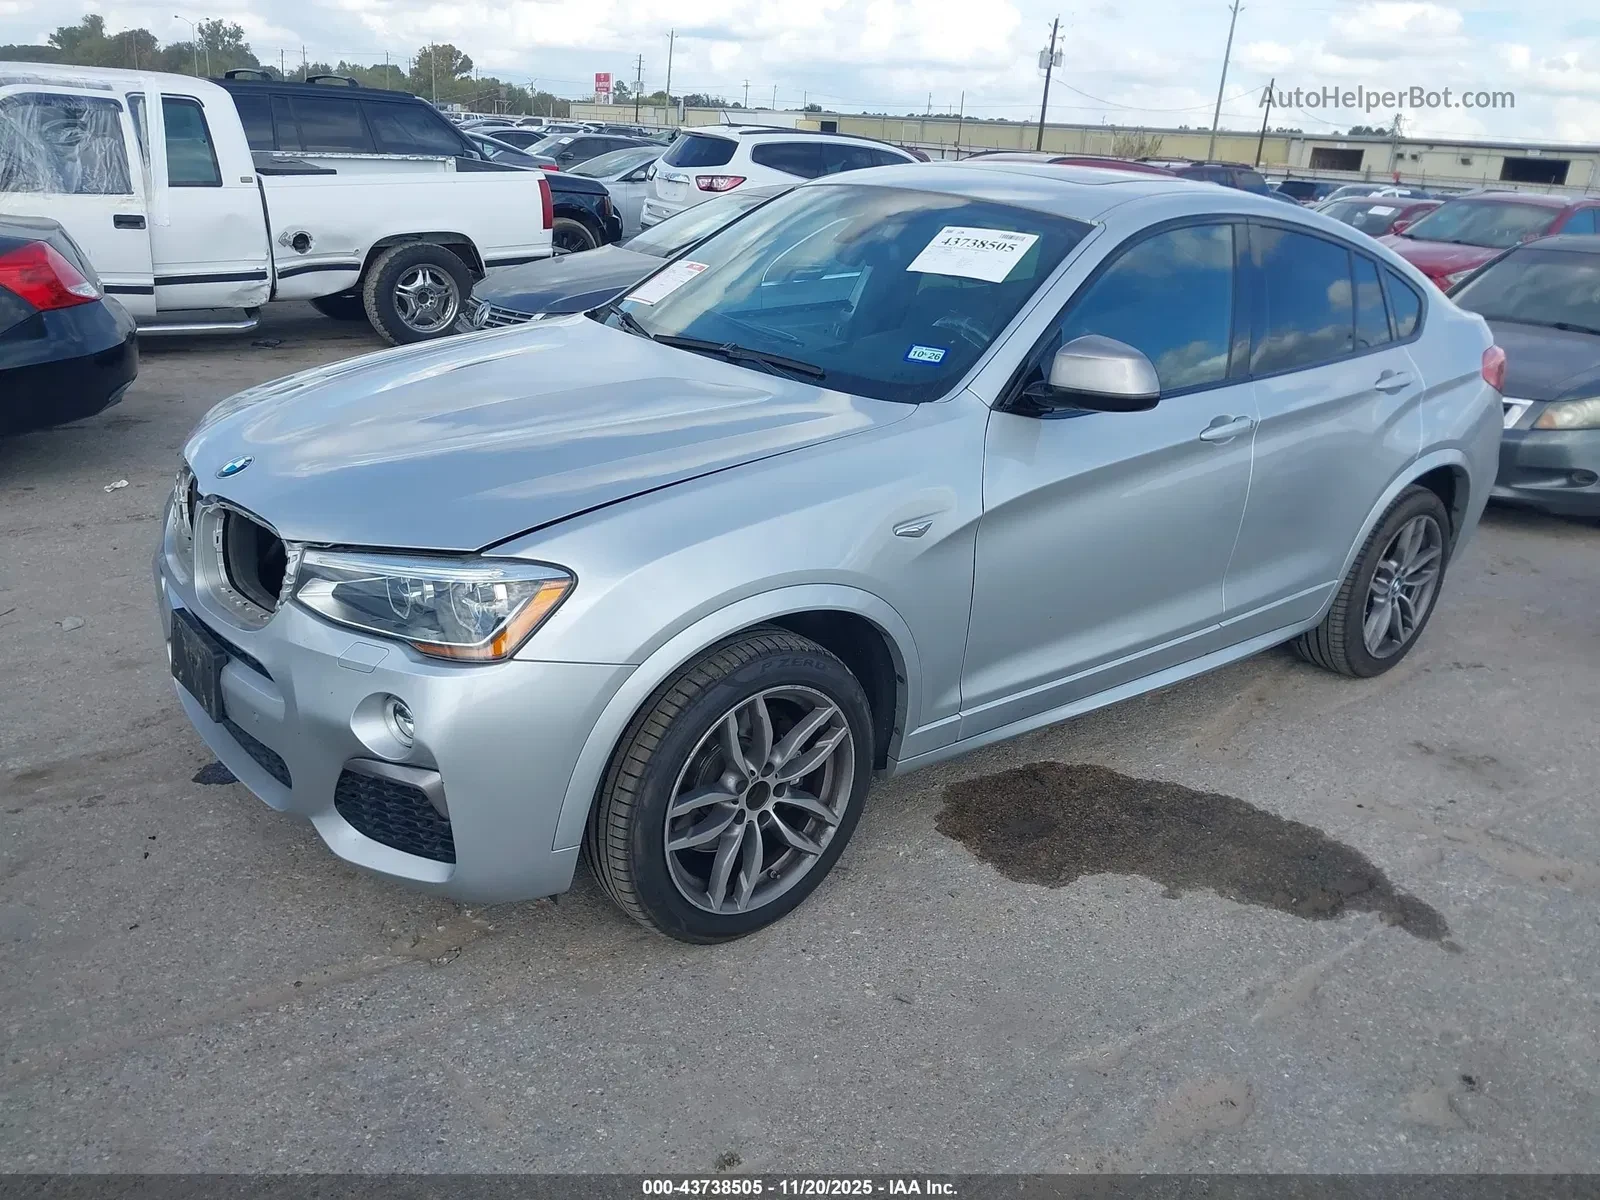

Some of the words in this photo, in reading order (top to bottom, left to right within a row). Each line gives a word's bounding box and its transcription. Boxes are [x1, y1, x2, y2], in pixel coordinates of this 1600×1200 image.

[941, 236, 1018, 253] 43738505
[912, 350, 925, 358] 10
[928, 352, 942, 361] 26
[761, 661, 773, 673] P
[778, 658, 827, 670] ZERO
